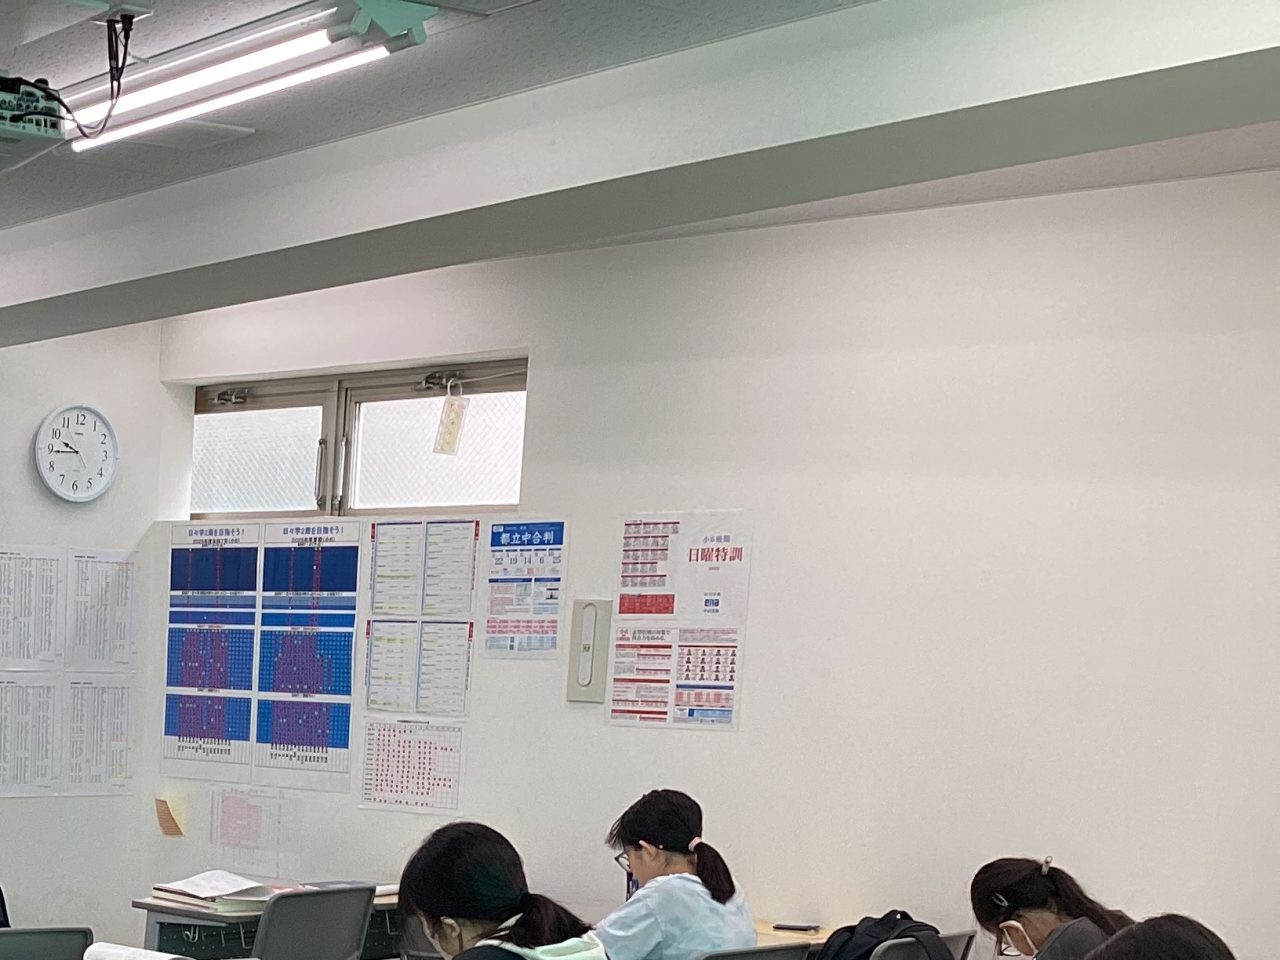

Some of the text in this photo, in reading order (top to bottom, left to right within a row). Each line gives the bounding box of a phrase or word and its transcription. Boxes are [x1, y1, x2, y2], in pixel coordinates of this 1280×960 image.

[62, 416, 70, 429] 11
[75, 413, 86, 426] 12
[93, 420, 97, 433] 1
[51, 427, 61, 440] 10
[100, 433, 107, 445] 2
[47, 442, 54, 455] 9
[101, 450, 108, 462] 3
[48, 460, 55, 473] 8
[97, 466, 104, 479] 4
[59, 473, 66, 486] 7
[71, 479, 79, 492] 6
[86, 477, 93, 490] 5
[500, 531, 554, 545] 都立中合判
[688, 547, 743, 562] 日曜特訓
[704, 599, 720, 608] ena
